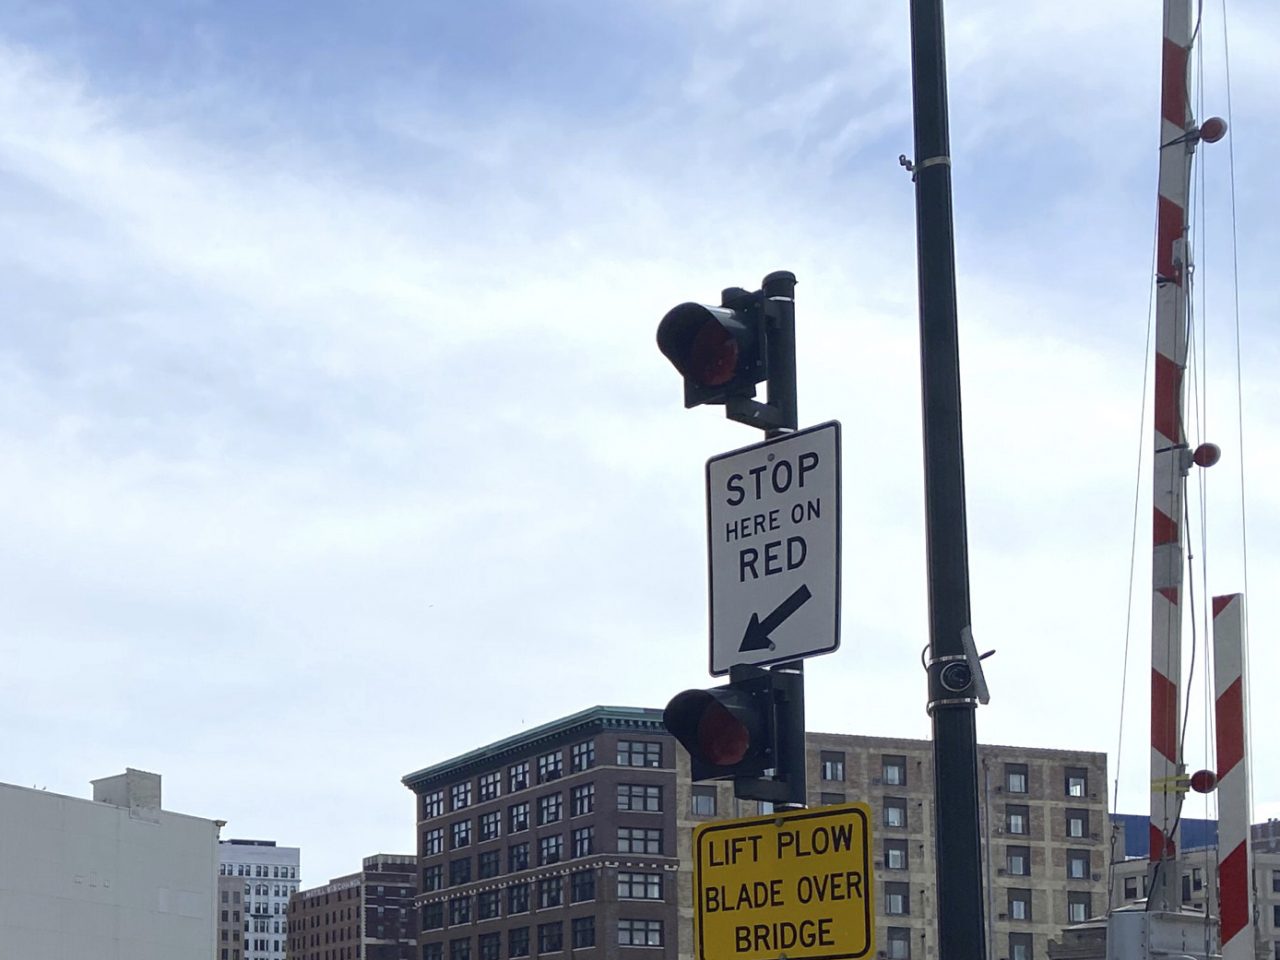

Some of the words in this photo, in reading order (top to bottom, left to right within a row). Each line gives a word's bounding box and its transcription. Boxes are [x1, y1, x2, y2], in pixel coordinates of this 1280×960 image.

[726, 451, 819, 507] STOP
[726, 509, 781, 543] HERE
[791, 498, 821, 525] ON
[739, 535, 807, 583] RED
[709, 835, 763, 867] LIFT
[777, 823, 853, 859] PLOW
[705, 879, 785, 913] BLADE
[797, 871, 862, 904] OVER
[735, 918, 835, 953] BRIDGE
